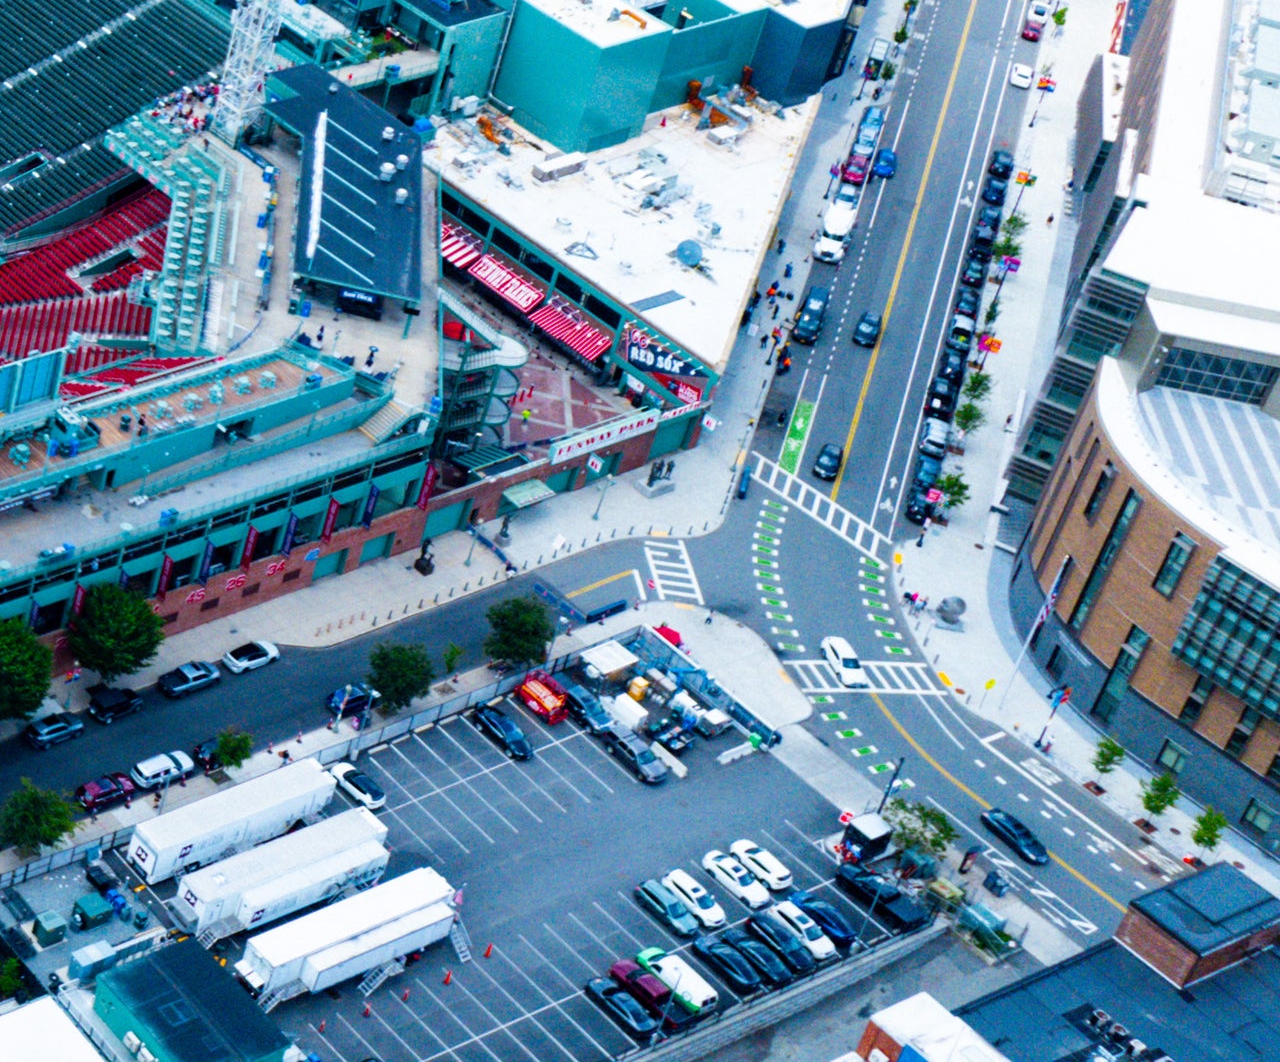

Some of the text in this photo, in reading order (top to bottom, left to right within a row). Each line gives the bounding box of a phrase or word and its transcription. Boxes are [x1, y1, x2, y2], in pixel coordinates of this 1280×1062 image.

[630, 346, 680, 374] RED SOX
[225, 575, 246, 592] 26
[186, 589, 206, 604] 45
